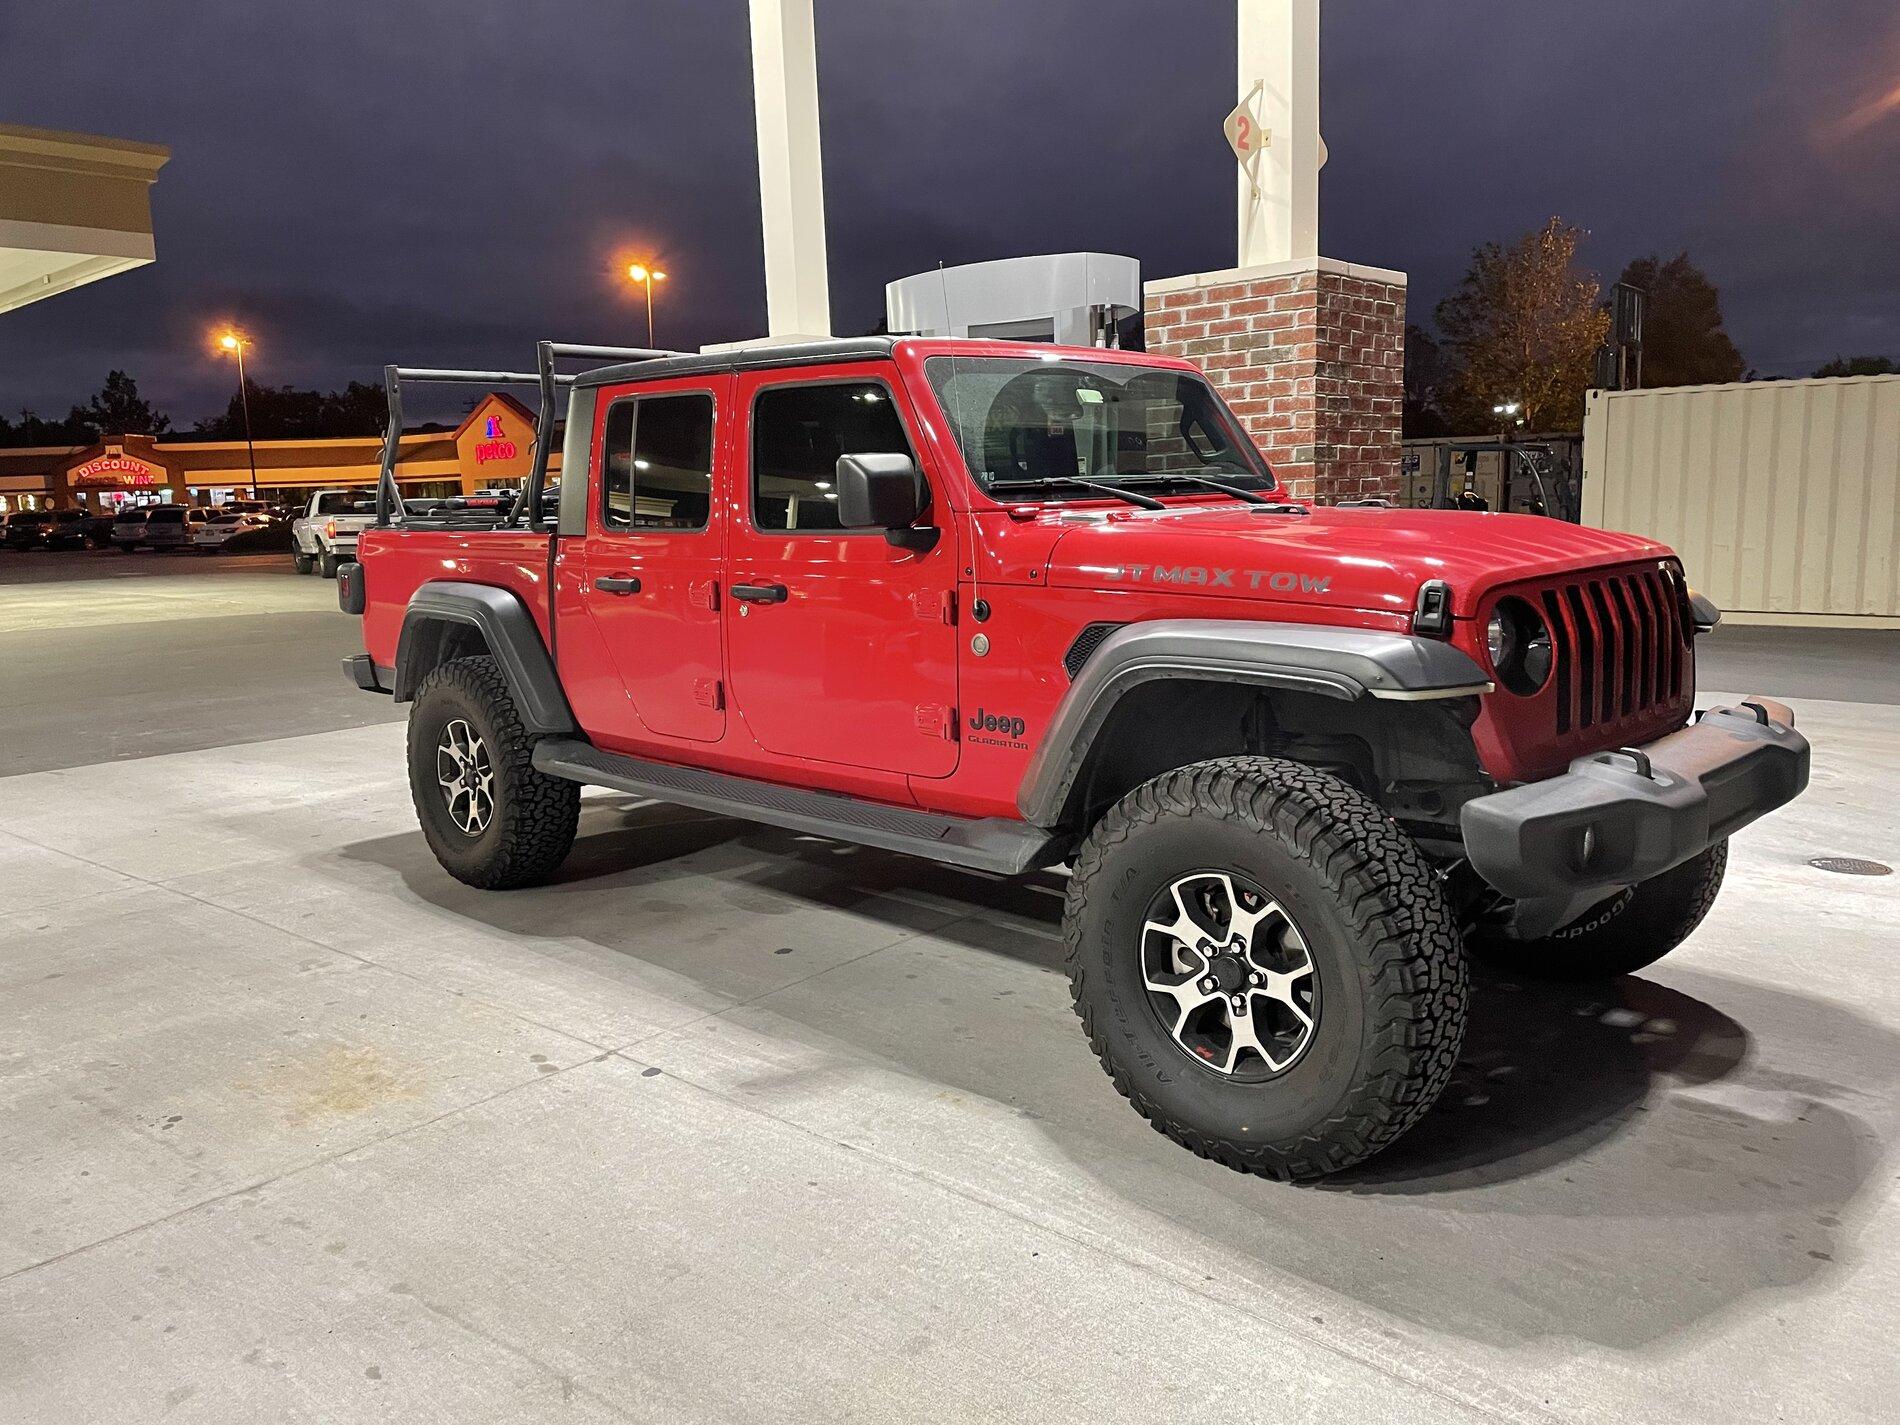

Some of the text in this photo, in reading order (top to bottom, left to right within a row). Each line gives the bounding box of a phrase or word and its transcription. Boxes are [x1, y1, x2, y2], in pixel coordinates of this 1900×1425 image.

[1236, 115, 1251, 151] 2
[476, 441, 515, 464] petco
[79, 460, 150, 478] DISCOUNT
[122, 475, 154, 485] WINE
[1104, 564, 1332, 596] JT MAX TOW
[969, 708, 1025, 739] Jeep
[968, 735, 1028, 750] GLADIATOR
